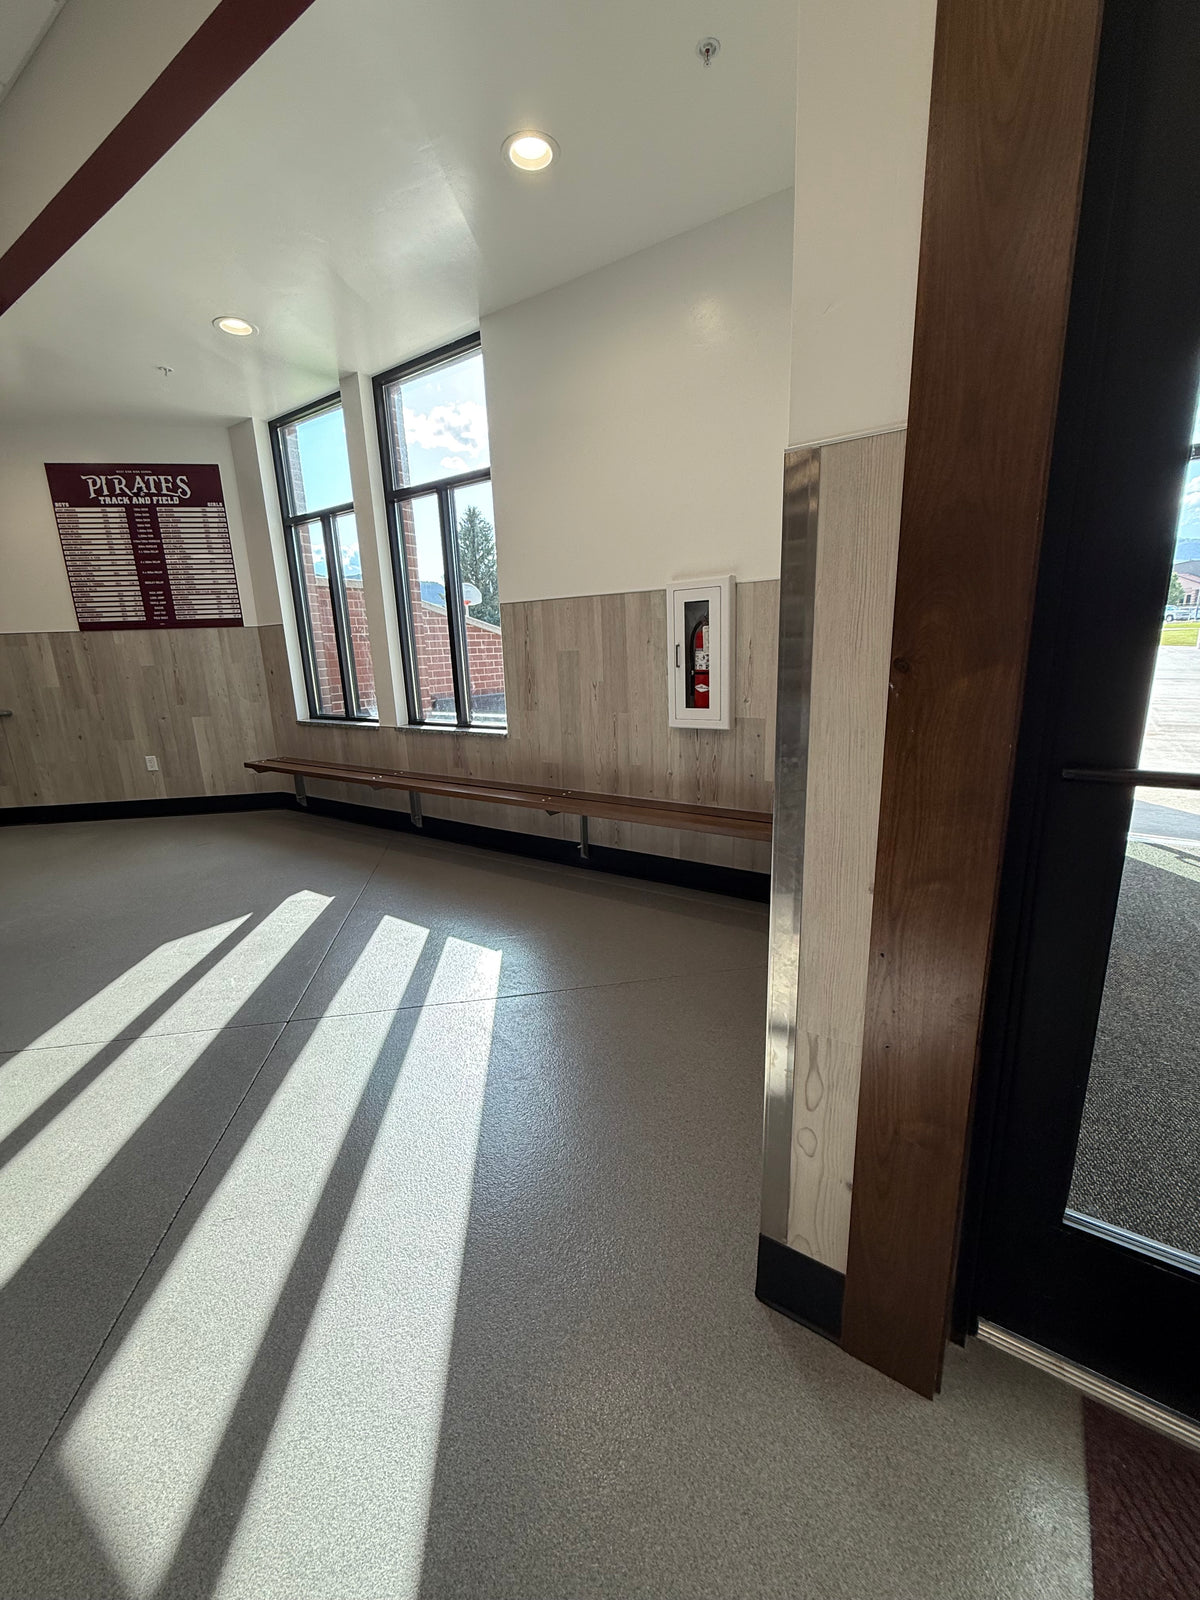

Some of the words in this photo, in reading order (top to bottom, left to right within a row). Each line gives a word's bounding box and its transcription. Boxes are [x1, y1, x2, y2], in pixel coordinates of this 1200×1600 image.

[80, 475, 191, 499] PIRATES
[98, 496, 130, 504] TRACK
[132, 496, 151, 504] AND
[153, 496, 179, 504] FIELD
